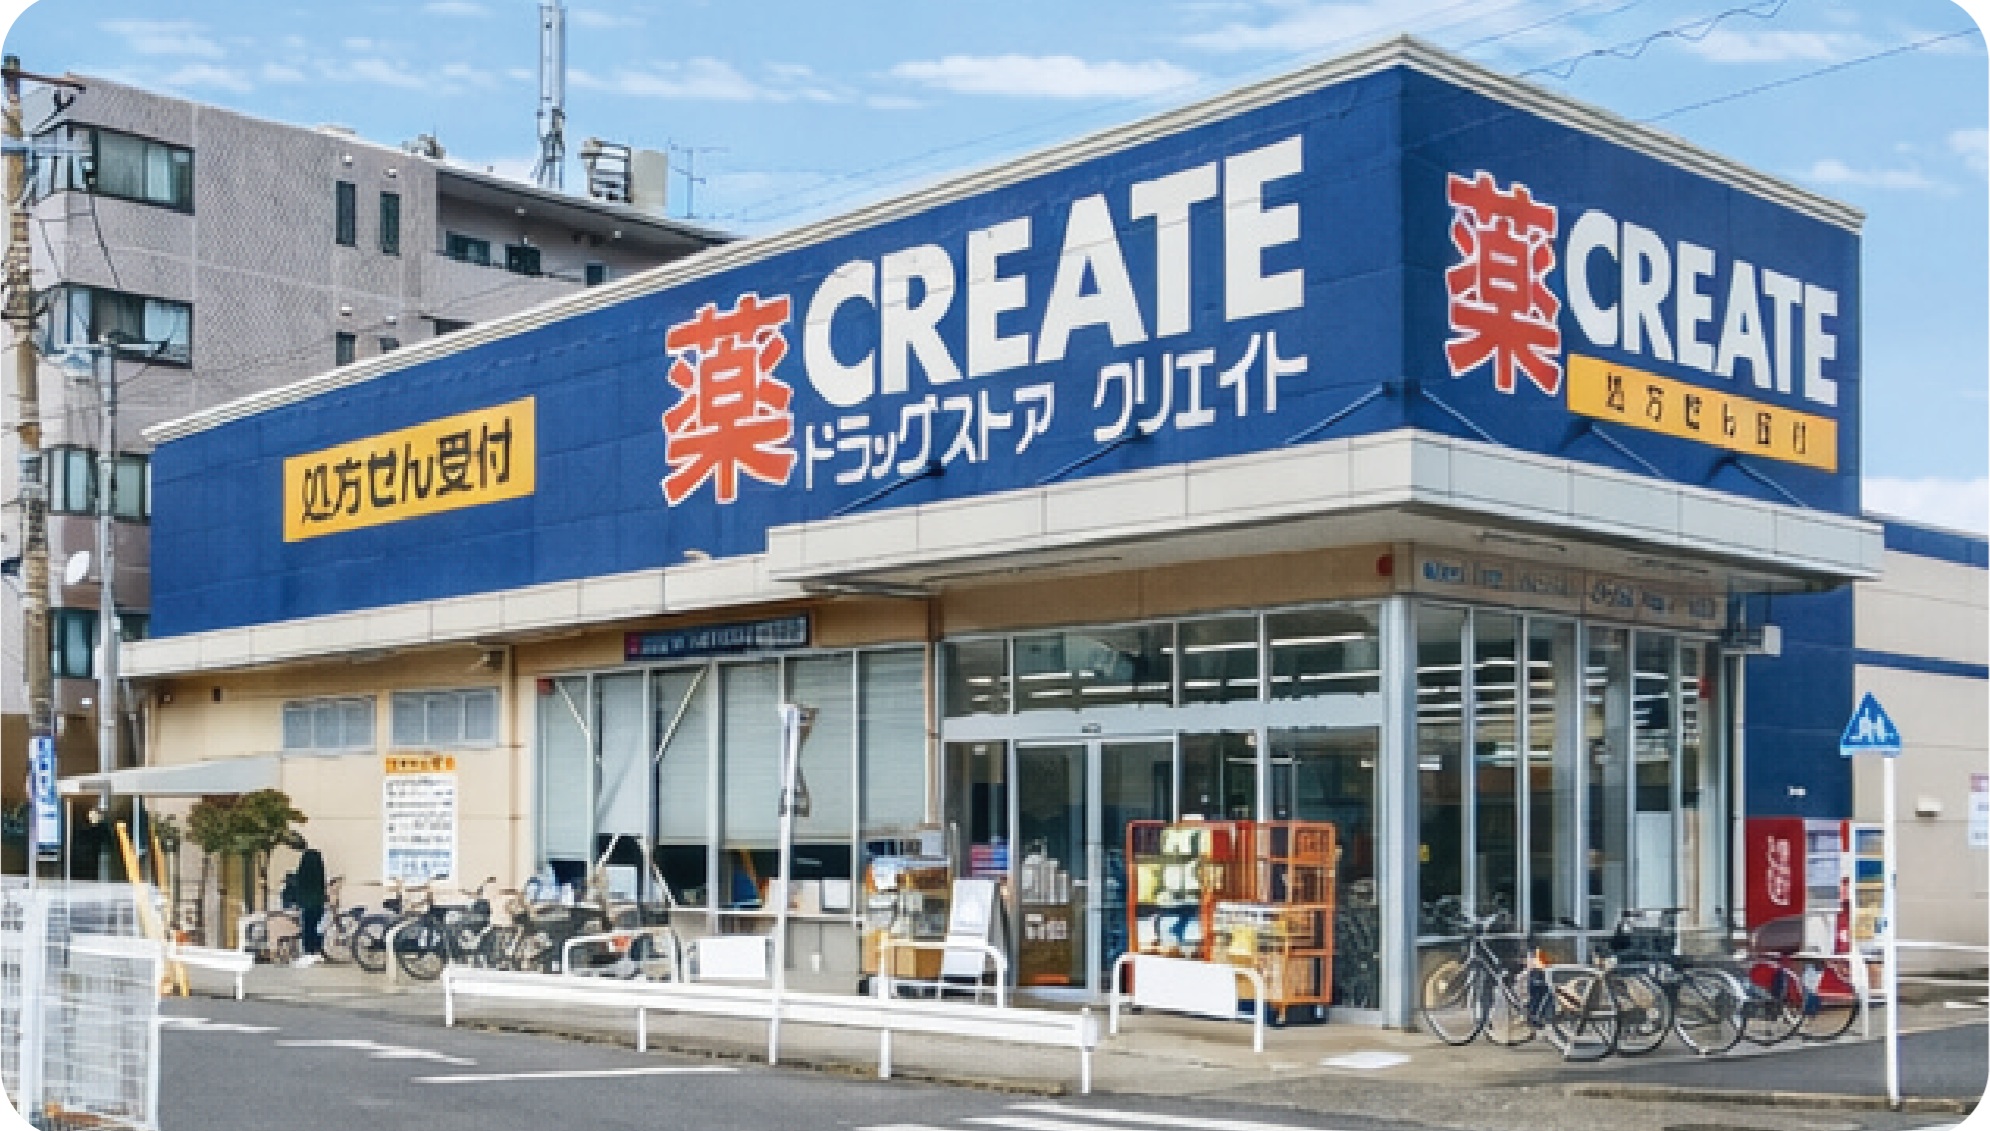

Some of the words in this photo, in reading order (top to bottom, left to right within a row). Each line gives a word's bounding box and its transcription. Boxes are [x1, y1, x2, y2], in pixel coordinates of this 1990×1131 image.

[803, 134, 1304, 408] CREATE
[1445, 169, 1563, 396] 薬
[1566, 208, 1838, 408] CREATE
[302, 415, 513, 525] 処方せん受付
[661, 292, 798, 507] 薬
[803, 380, 1056, 490] ドラッグストア
[1093, 330, 1309, 442] クリエイト
